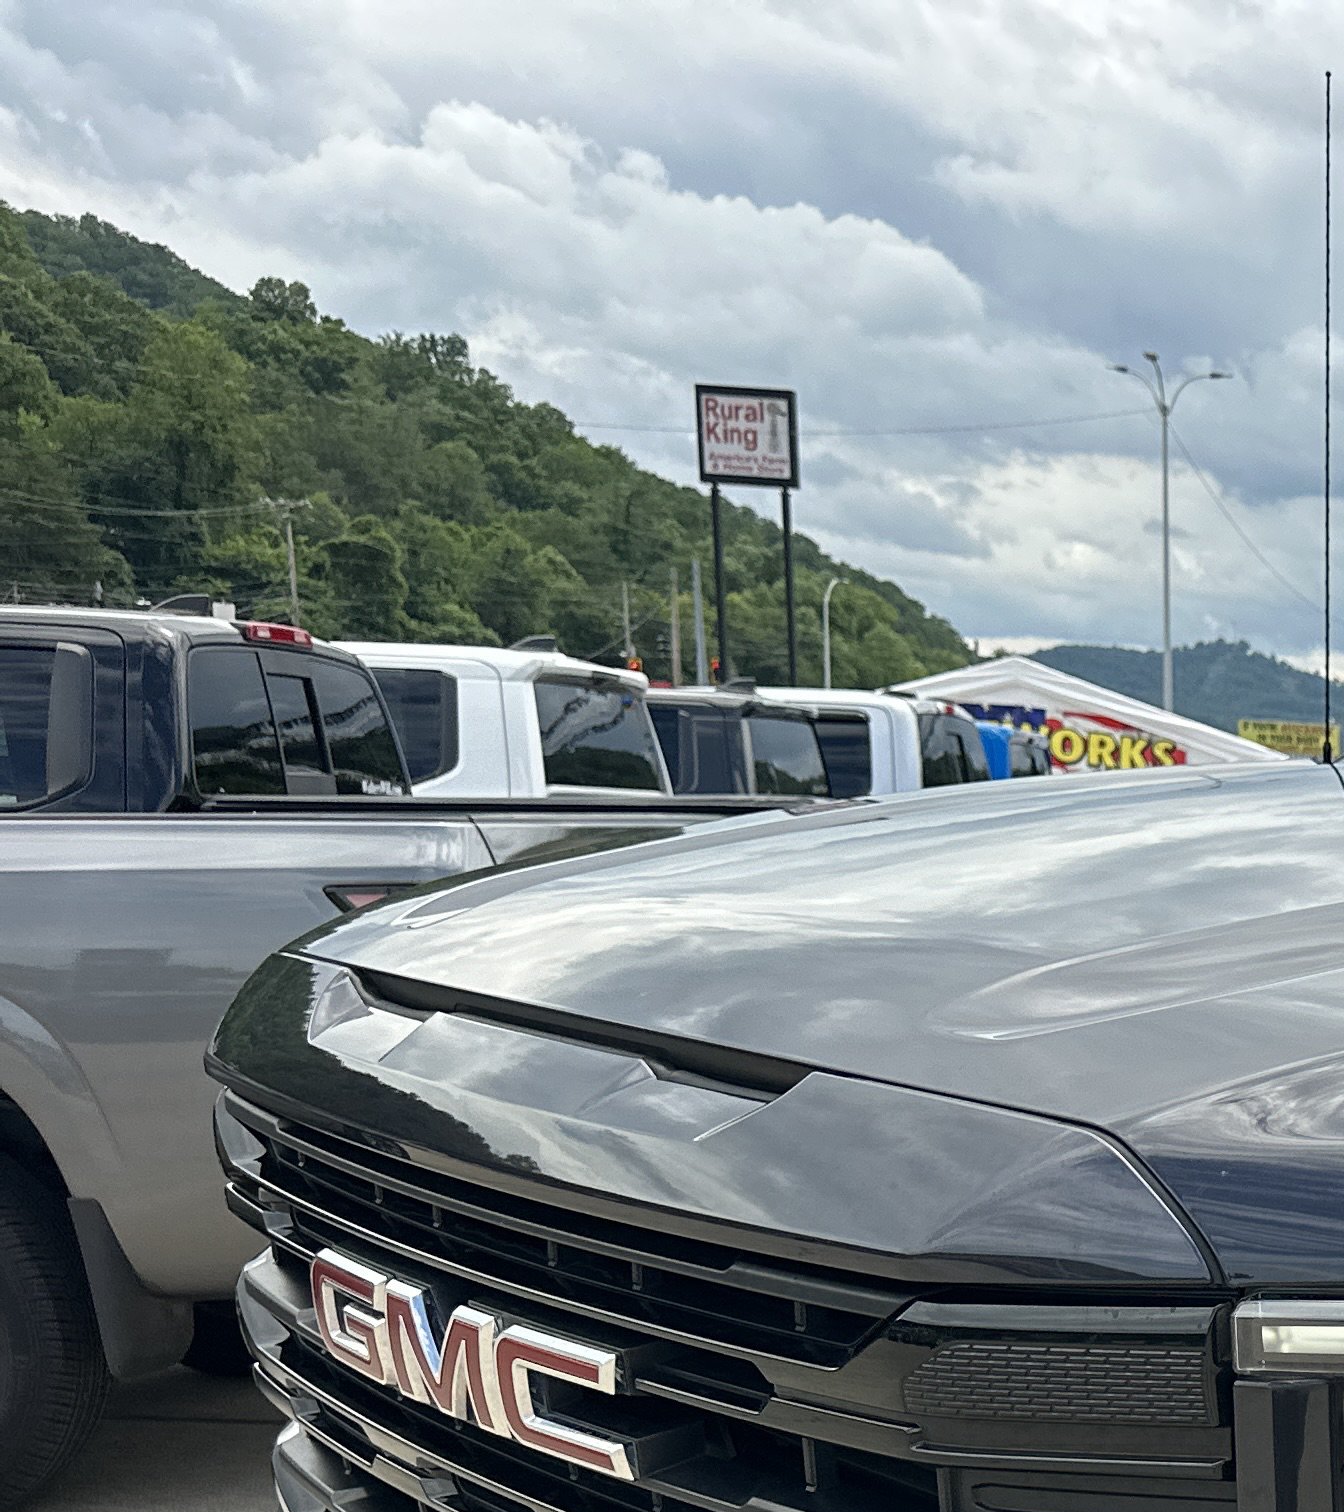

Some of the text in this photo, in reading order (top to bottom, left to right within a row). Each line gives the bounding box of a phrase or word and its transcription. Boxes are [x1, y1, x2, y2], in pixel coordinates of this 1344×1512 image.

[704, 397, 764, 423] Rural
[705, 420, 758, 451] King
[1025, 724, 1178, 769] ORKS
[311, 1247, 635, 1481] GMC
